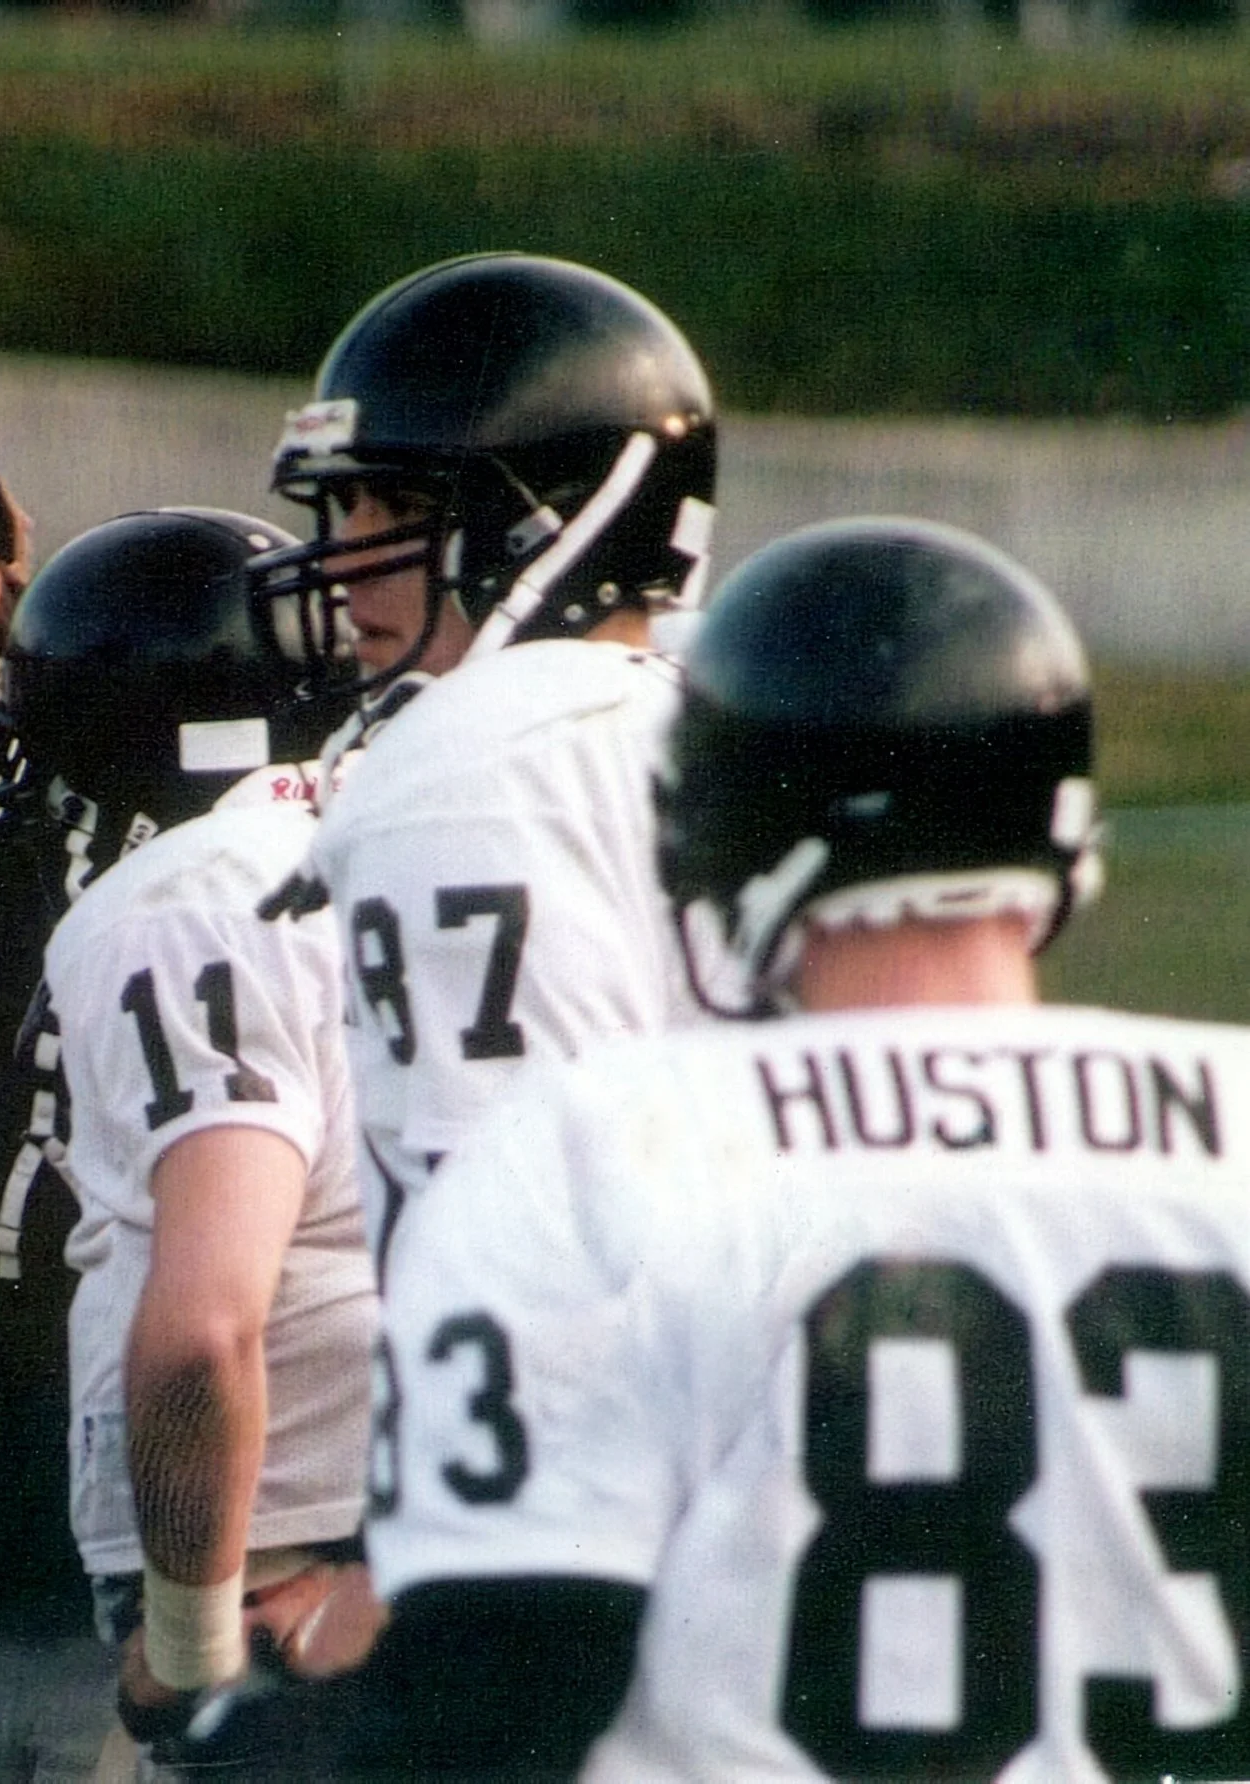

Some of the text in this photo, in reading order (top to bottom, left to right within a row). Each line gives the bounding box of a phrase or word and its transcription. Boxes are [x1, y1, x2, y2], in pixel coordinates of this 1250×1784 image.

[120, 960, 279, 1132] 11
[352, 883, 531, 1067] 87
[756, 1044, 1226, 1160] HUSTON
[776, 1256, 1250, 1784] 83
